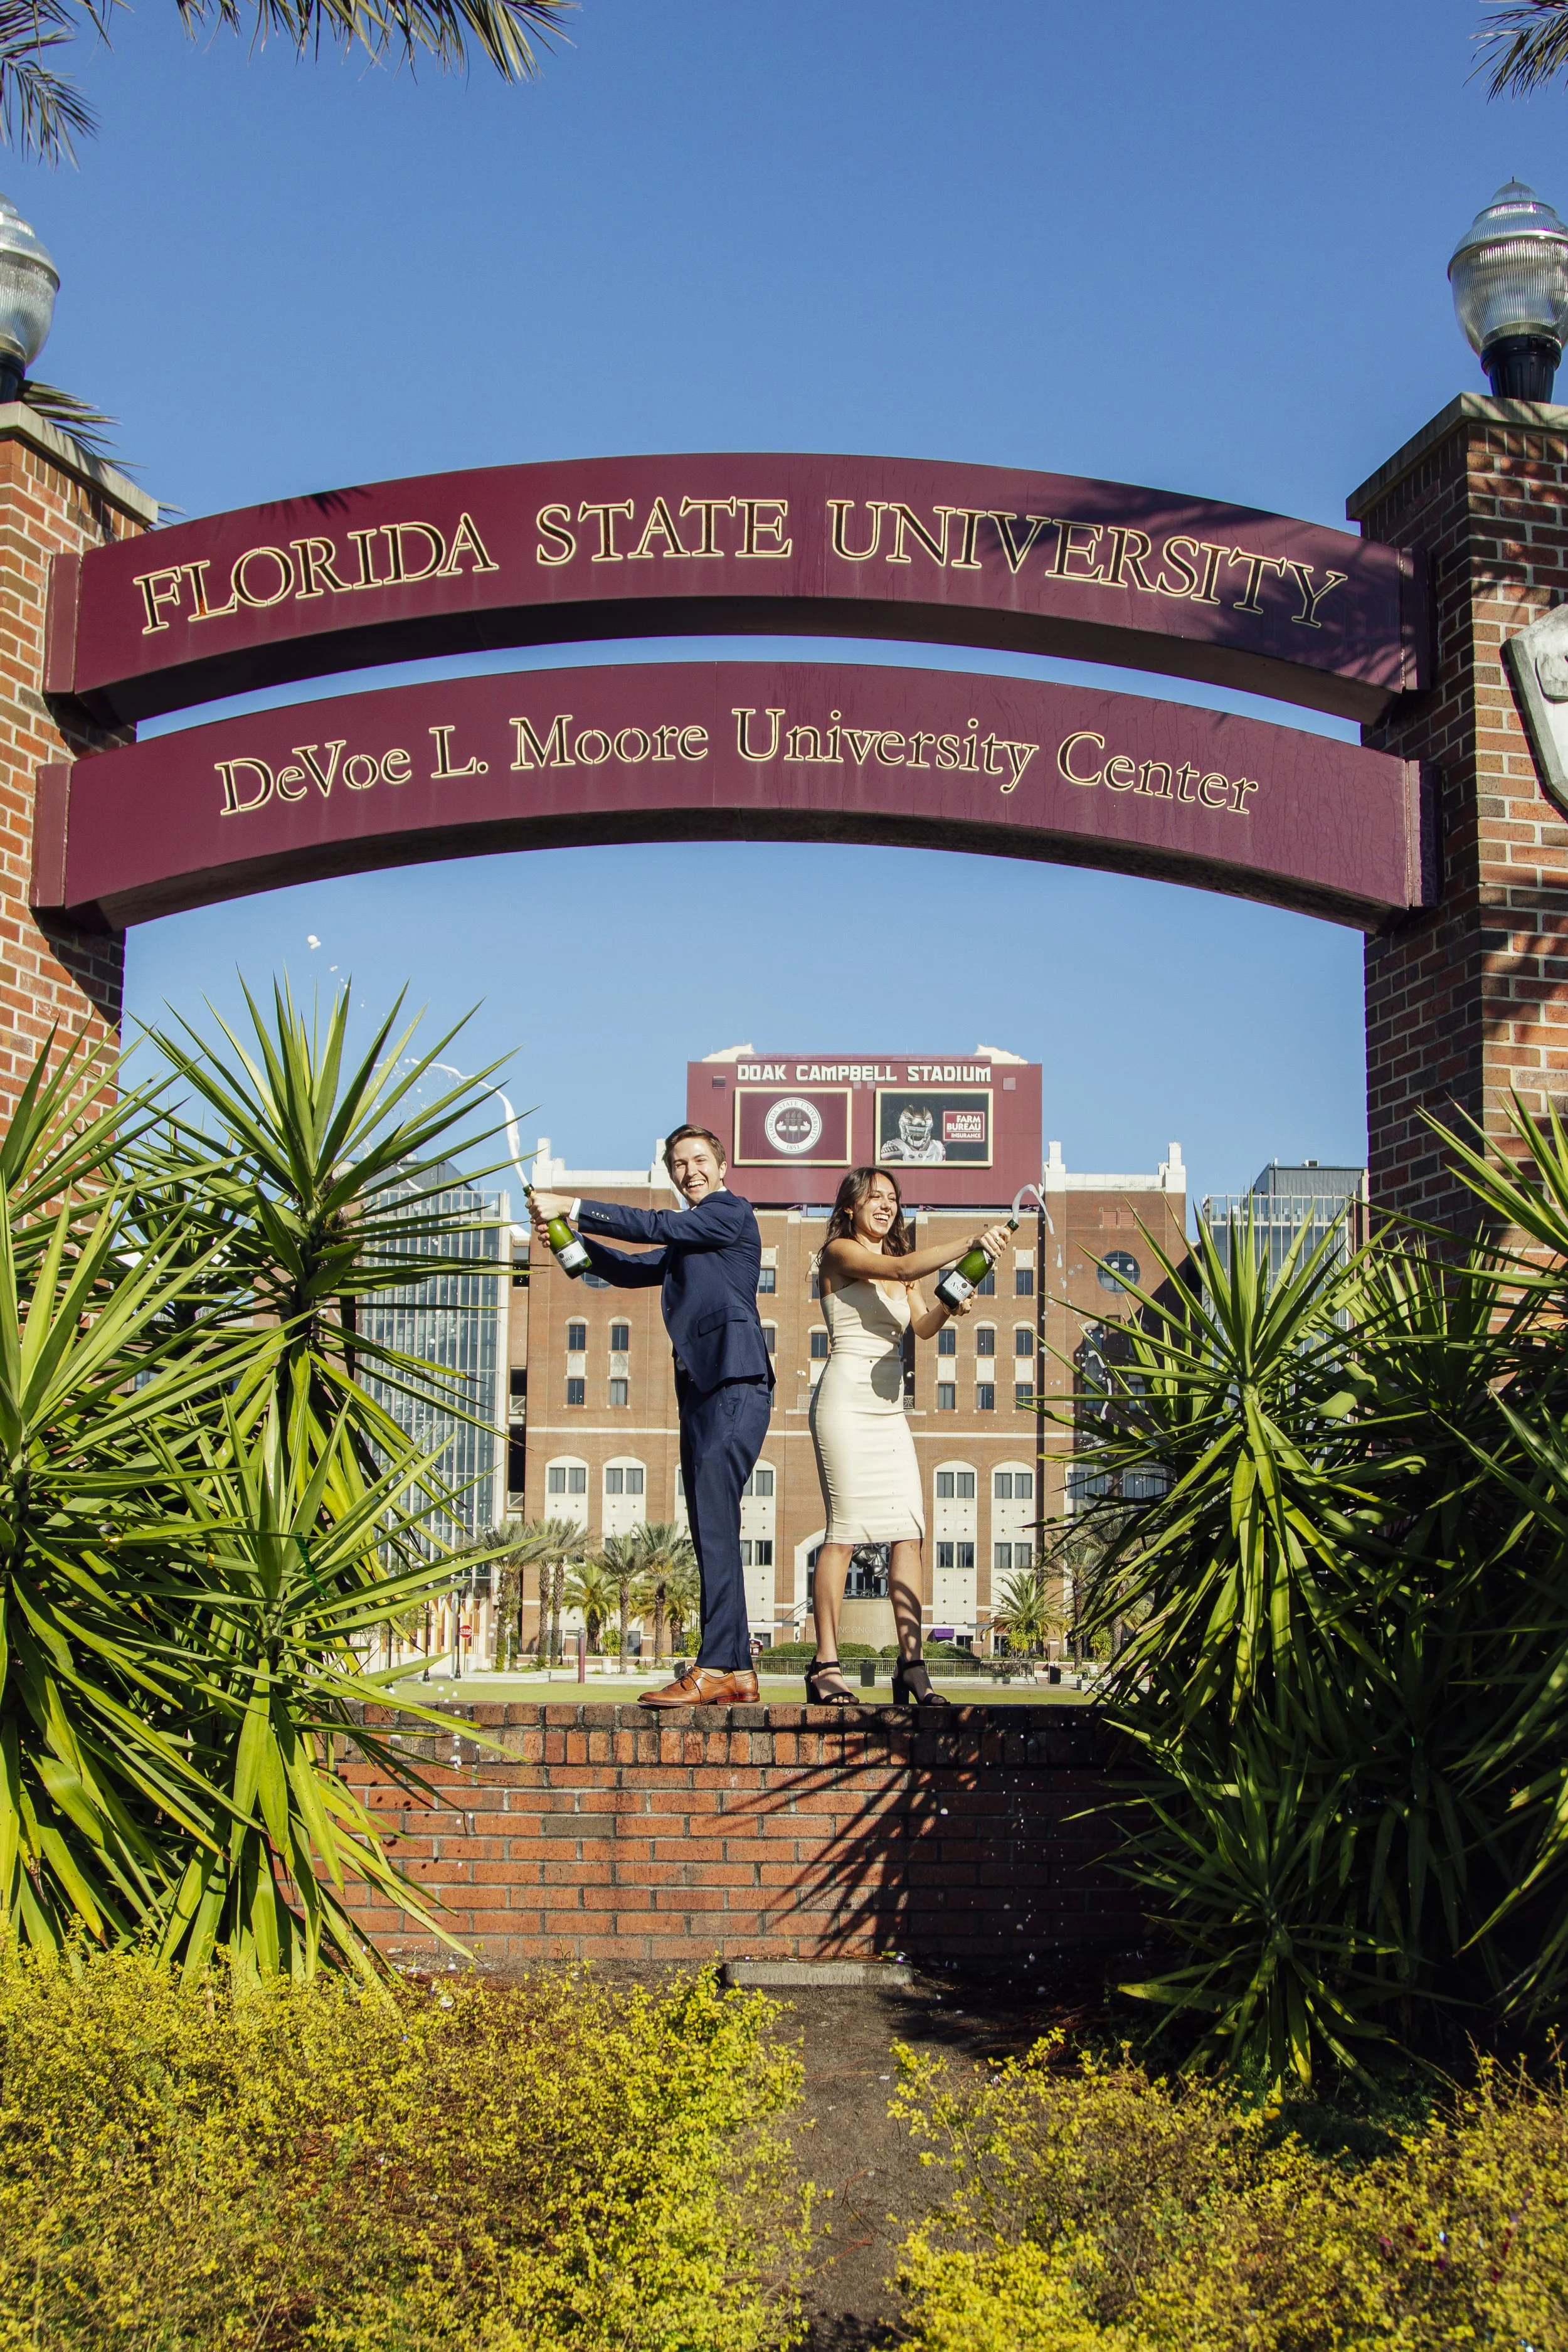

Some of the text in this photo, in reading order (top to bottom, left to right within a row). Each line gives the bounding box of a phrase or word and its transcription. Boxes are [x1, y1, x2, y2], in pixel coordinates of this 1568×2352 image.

[132, 496, 1348, 635] FLORIDA STATE UNIVERSITY
[214, 708, 1259, 815] DeVoe L. Moore University Center
[737, 1064, 992, 1083] DOAK CAMPBELL STADIUM
[768, 1101, 818, 1140] FLORIDA STATE UNIVERSITY
[946, 1123, 982, 1131] BUREAU
[956, 1115, 982, 1123] FARM
